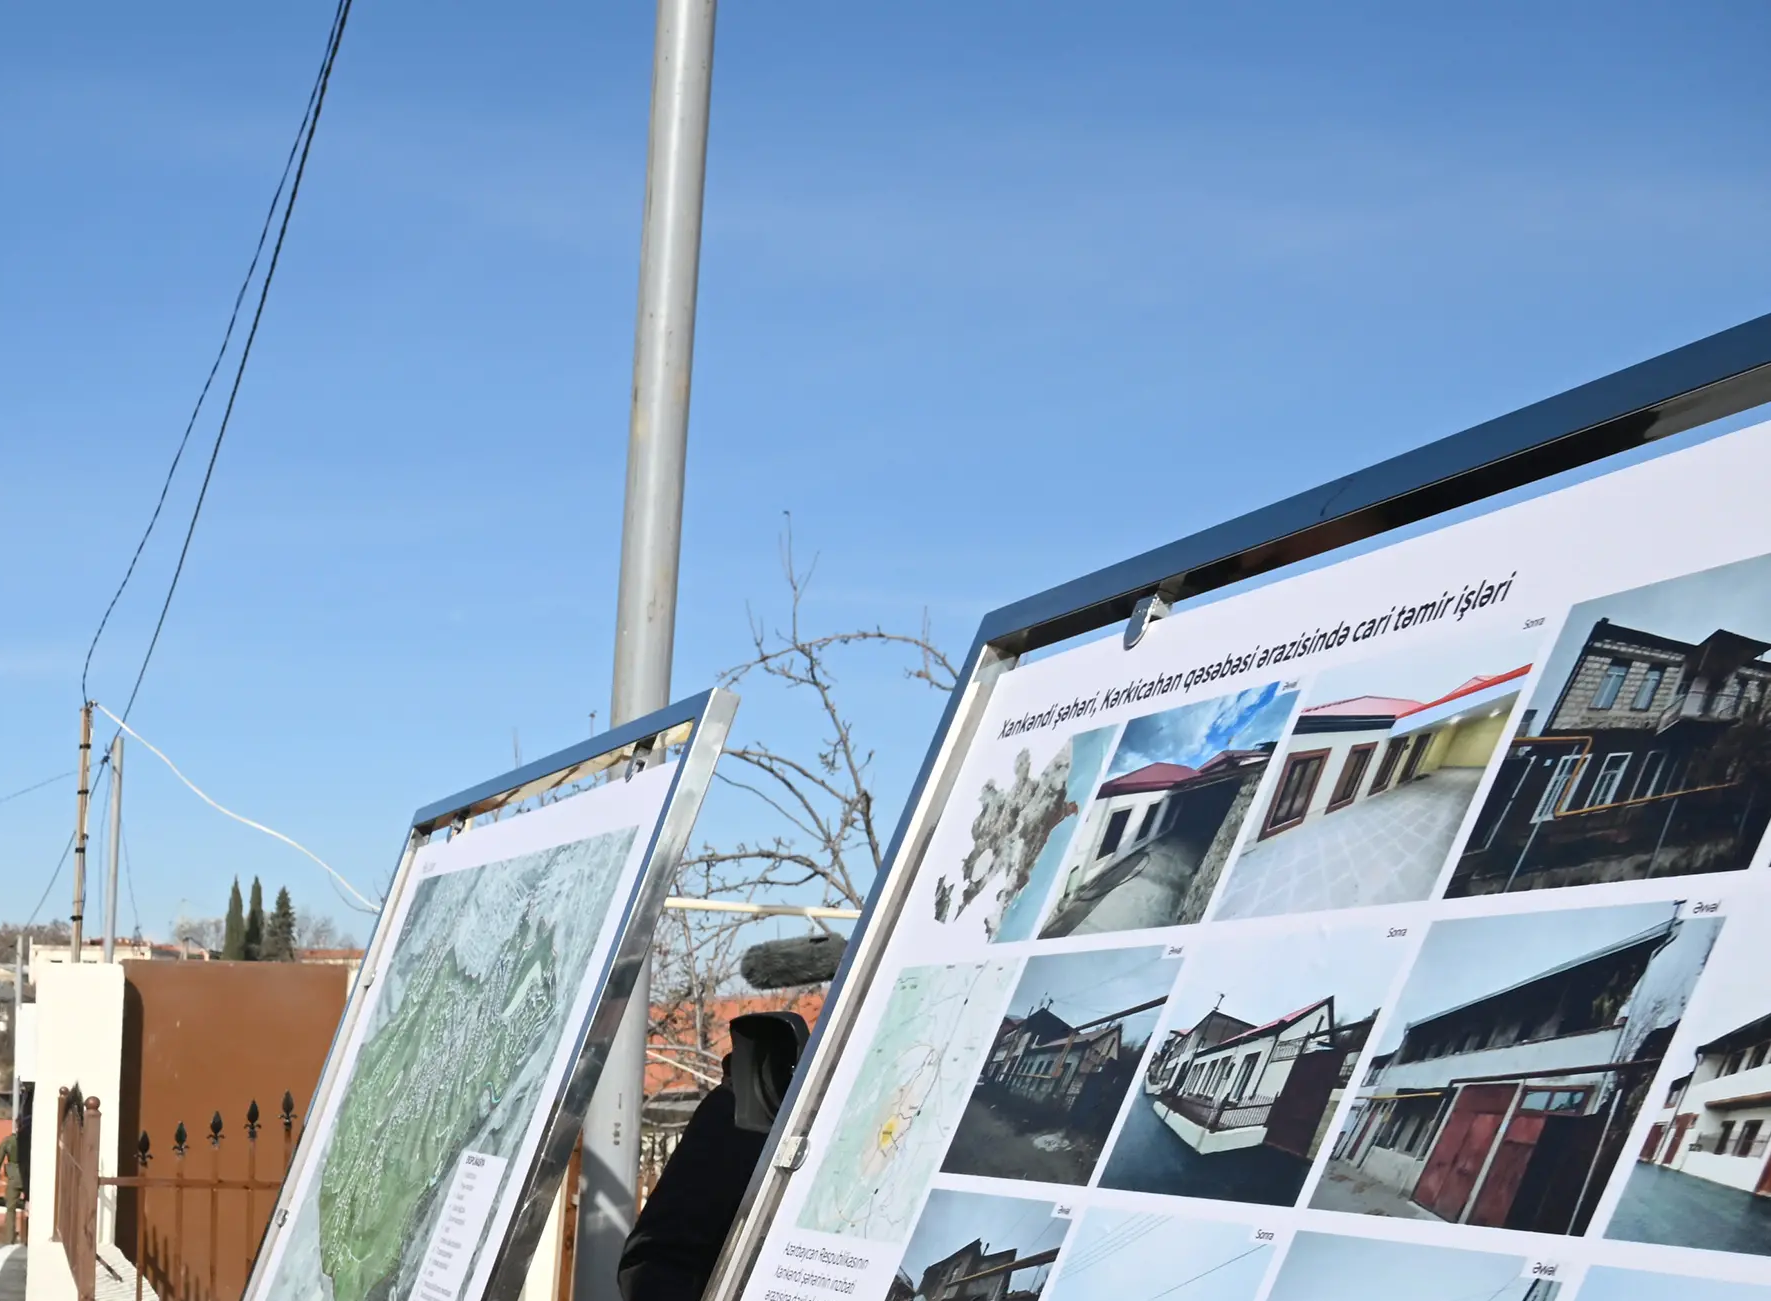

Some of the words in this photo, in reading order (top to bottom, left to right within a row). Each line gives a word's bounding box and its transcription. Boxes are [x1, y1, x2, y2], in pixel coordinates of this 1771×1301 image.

[997, 705, 1055, 740] Xankəndi
[1052, 691, 1099, 730] şəhəri,
[1100, 672, 1183, 711] Kərkicahan
[1183, 645, 1260, 692] qəsəbəsi
[1256, 621, 1348, 669] ərazisində
[1352, 606, 1395, 642] cari
[1392, 591, 1455, 631] təmir
[1453, 570, 1517, 621] işləri
